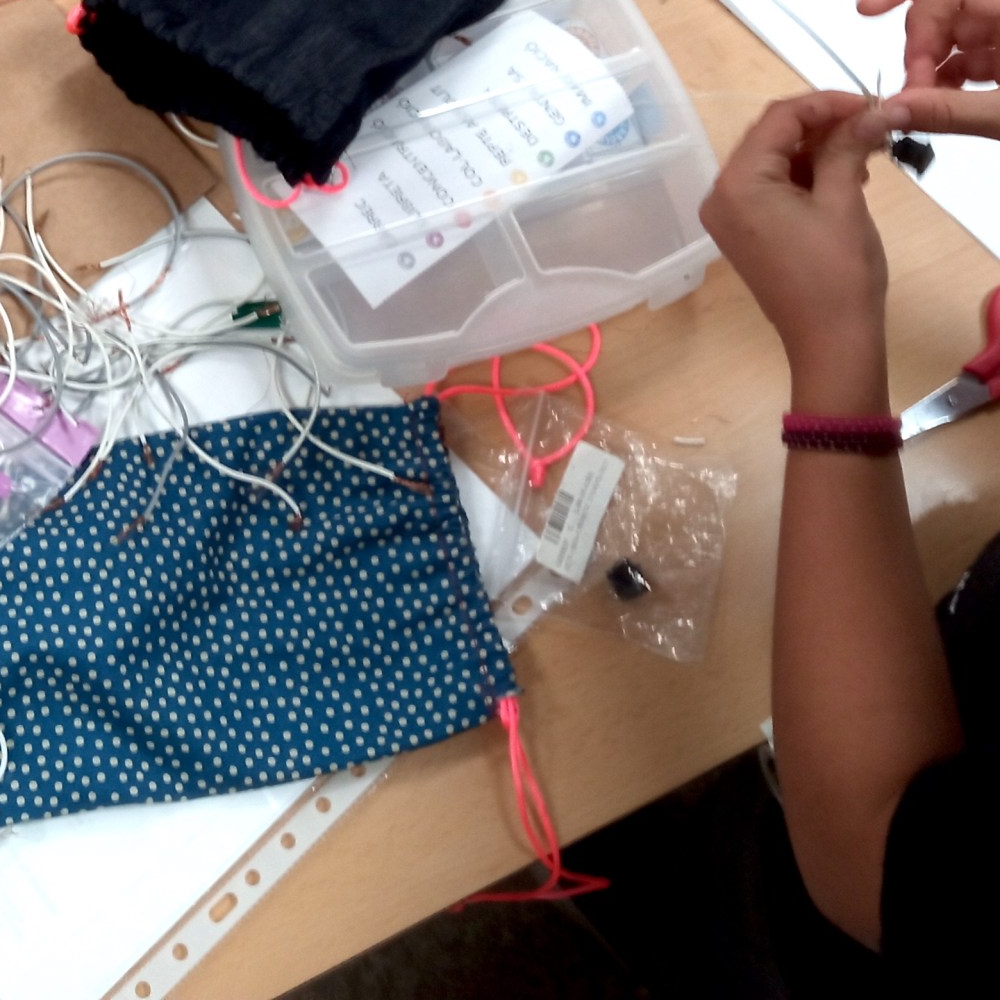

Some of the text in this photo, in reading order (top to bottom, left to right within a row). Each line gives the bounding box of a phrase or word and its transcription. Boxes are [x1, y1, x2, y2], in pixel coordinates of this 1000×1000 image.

[506, 66, 566, 128] GENTSA
[524, 40, 593, 108] IMANACIÓ
[371, 117, 456, 208] CONCENTRAÓ
[396, 96, 484, 189] COLLABOCIÓ
[376, 171, 429, 227] LIBRETA
